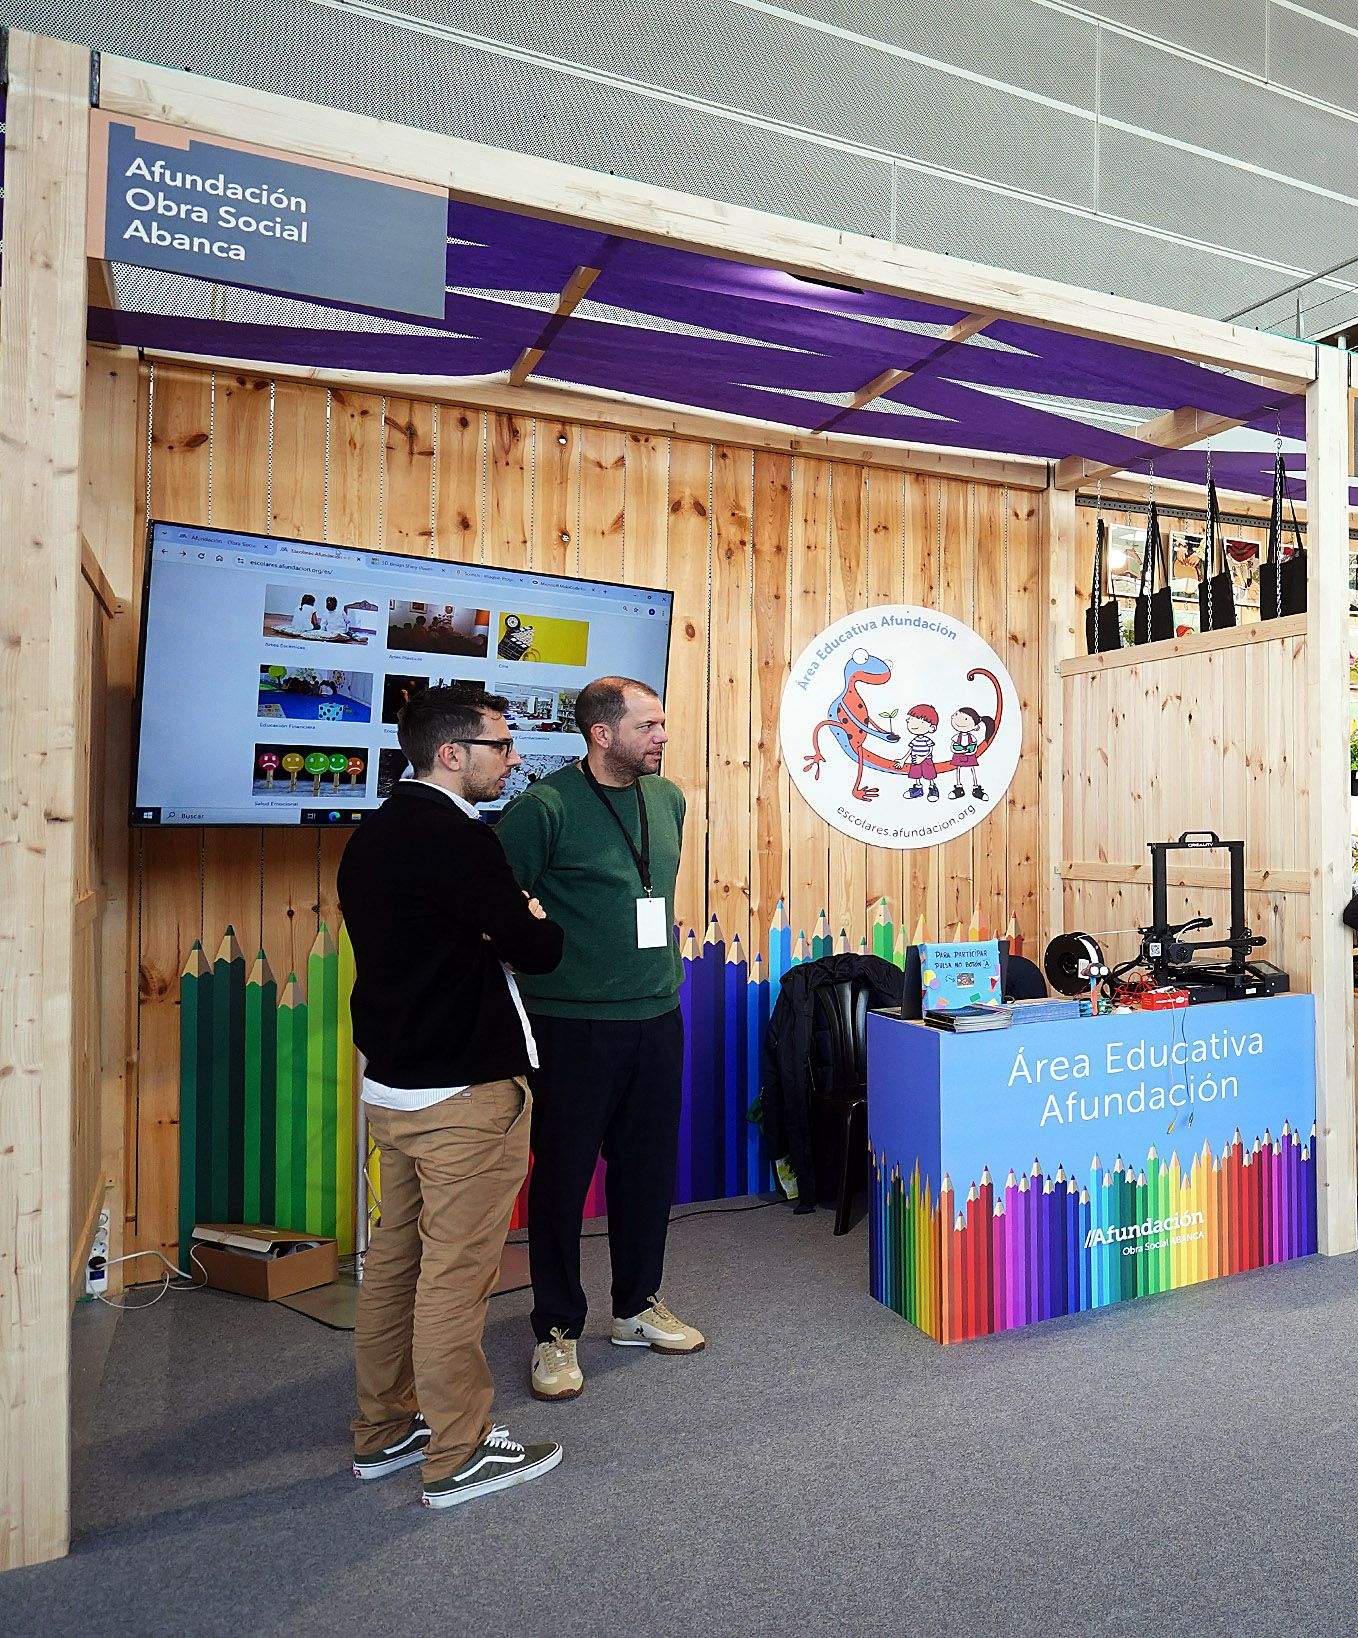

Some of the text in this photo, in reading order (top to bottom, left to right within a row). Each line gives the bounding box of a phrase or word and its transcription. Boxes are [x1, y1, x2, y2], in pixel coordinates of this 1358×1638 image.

[125, 157, 307, 213] Afundación
[125, 187, 308, 243] Obra Social
[122, 219, 246, 261] Abanca
[249, 559, 334, 575] escolares.afundacion.org/es/
[798, 614, 958, 691] Área Educativa Afundación
[181, 812, 205, 820] Buscar
[836, 803, 977, 838] escolares.afundacion.org
[934, 949, 988, 959] PARA PARTICIPAR
[1007, 1029, 1264, 1087] Área Educativa
[1039, 1072, 1239, 1127] Afundación
[1122, 1245, 1144, 1256] Obra
[1144, 1238, 1169, 1251] Social
